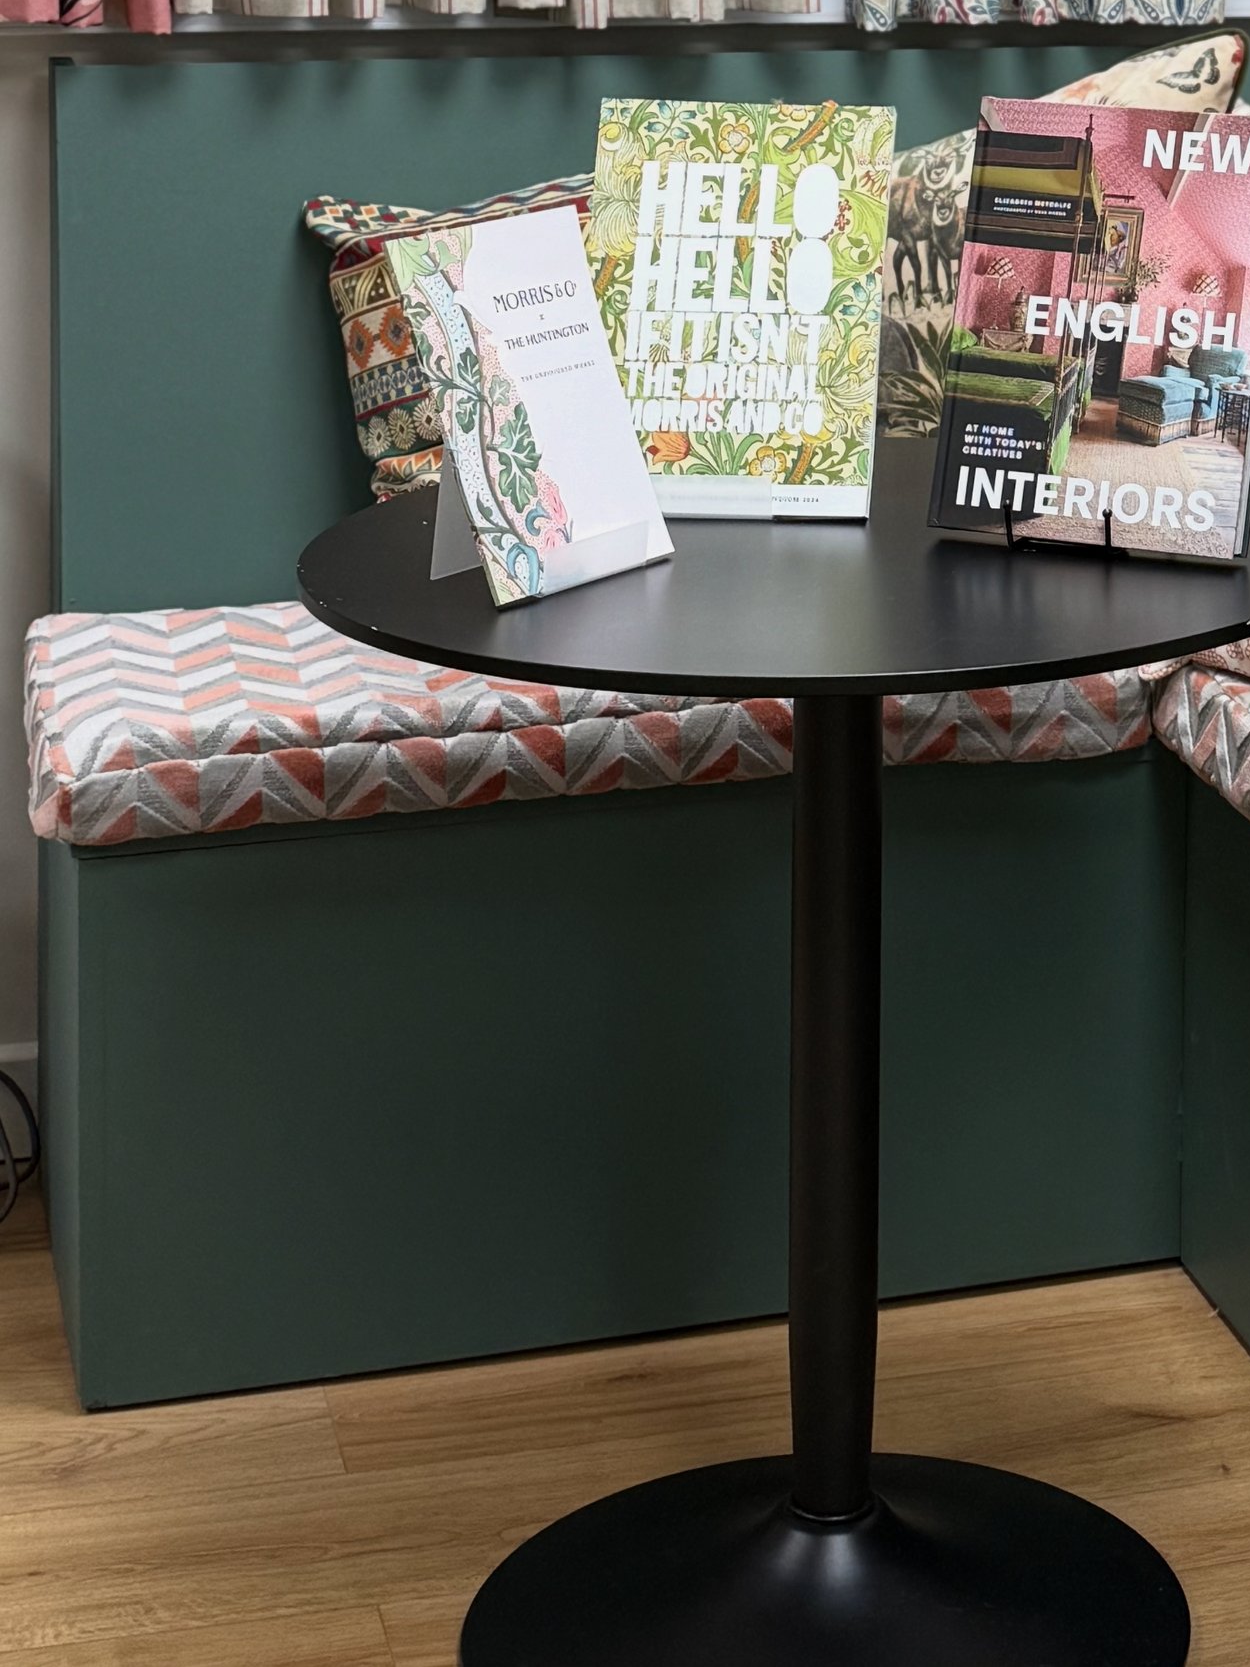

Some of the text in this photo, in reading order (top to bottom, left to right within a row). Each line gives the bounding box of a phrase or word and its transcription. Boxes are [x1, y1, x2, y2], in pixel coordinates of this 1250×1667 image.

[638, 160, 839, 235] HELLO
[631, 236, 833, 314] HELLO
[493, 285, 553, 313] MORRIS
[504, 323, 589, 350] THE HUNTINGTON
[625, 311, 830, 364] IF IT ISN'T
[1025, 295, 1236, 352] ENGLISH
[624, 362, 819, 400] THE ORIGINAL
[631, 399, 823, 435] MORRIS AND CO
[965, 424, 1014, 436] AT HOME
[962, 446, 1022, 459] CREATIVES
[964, 434, 1042, 450] WITH TODAY'S
[956, 466, 1216, 532] INTERIORS
